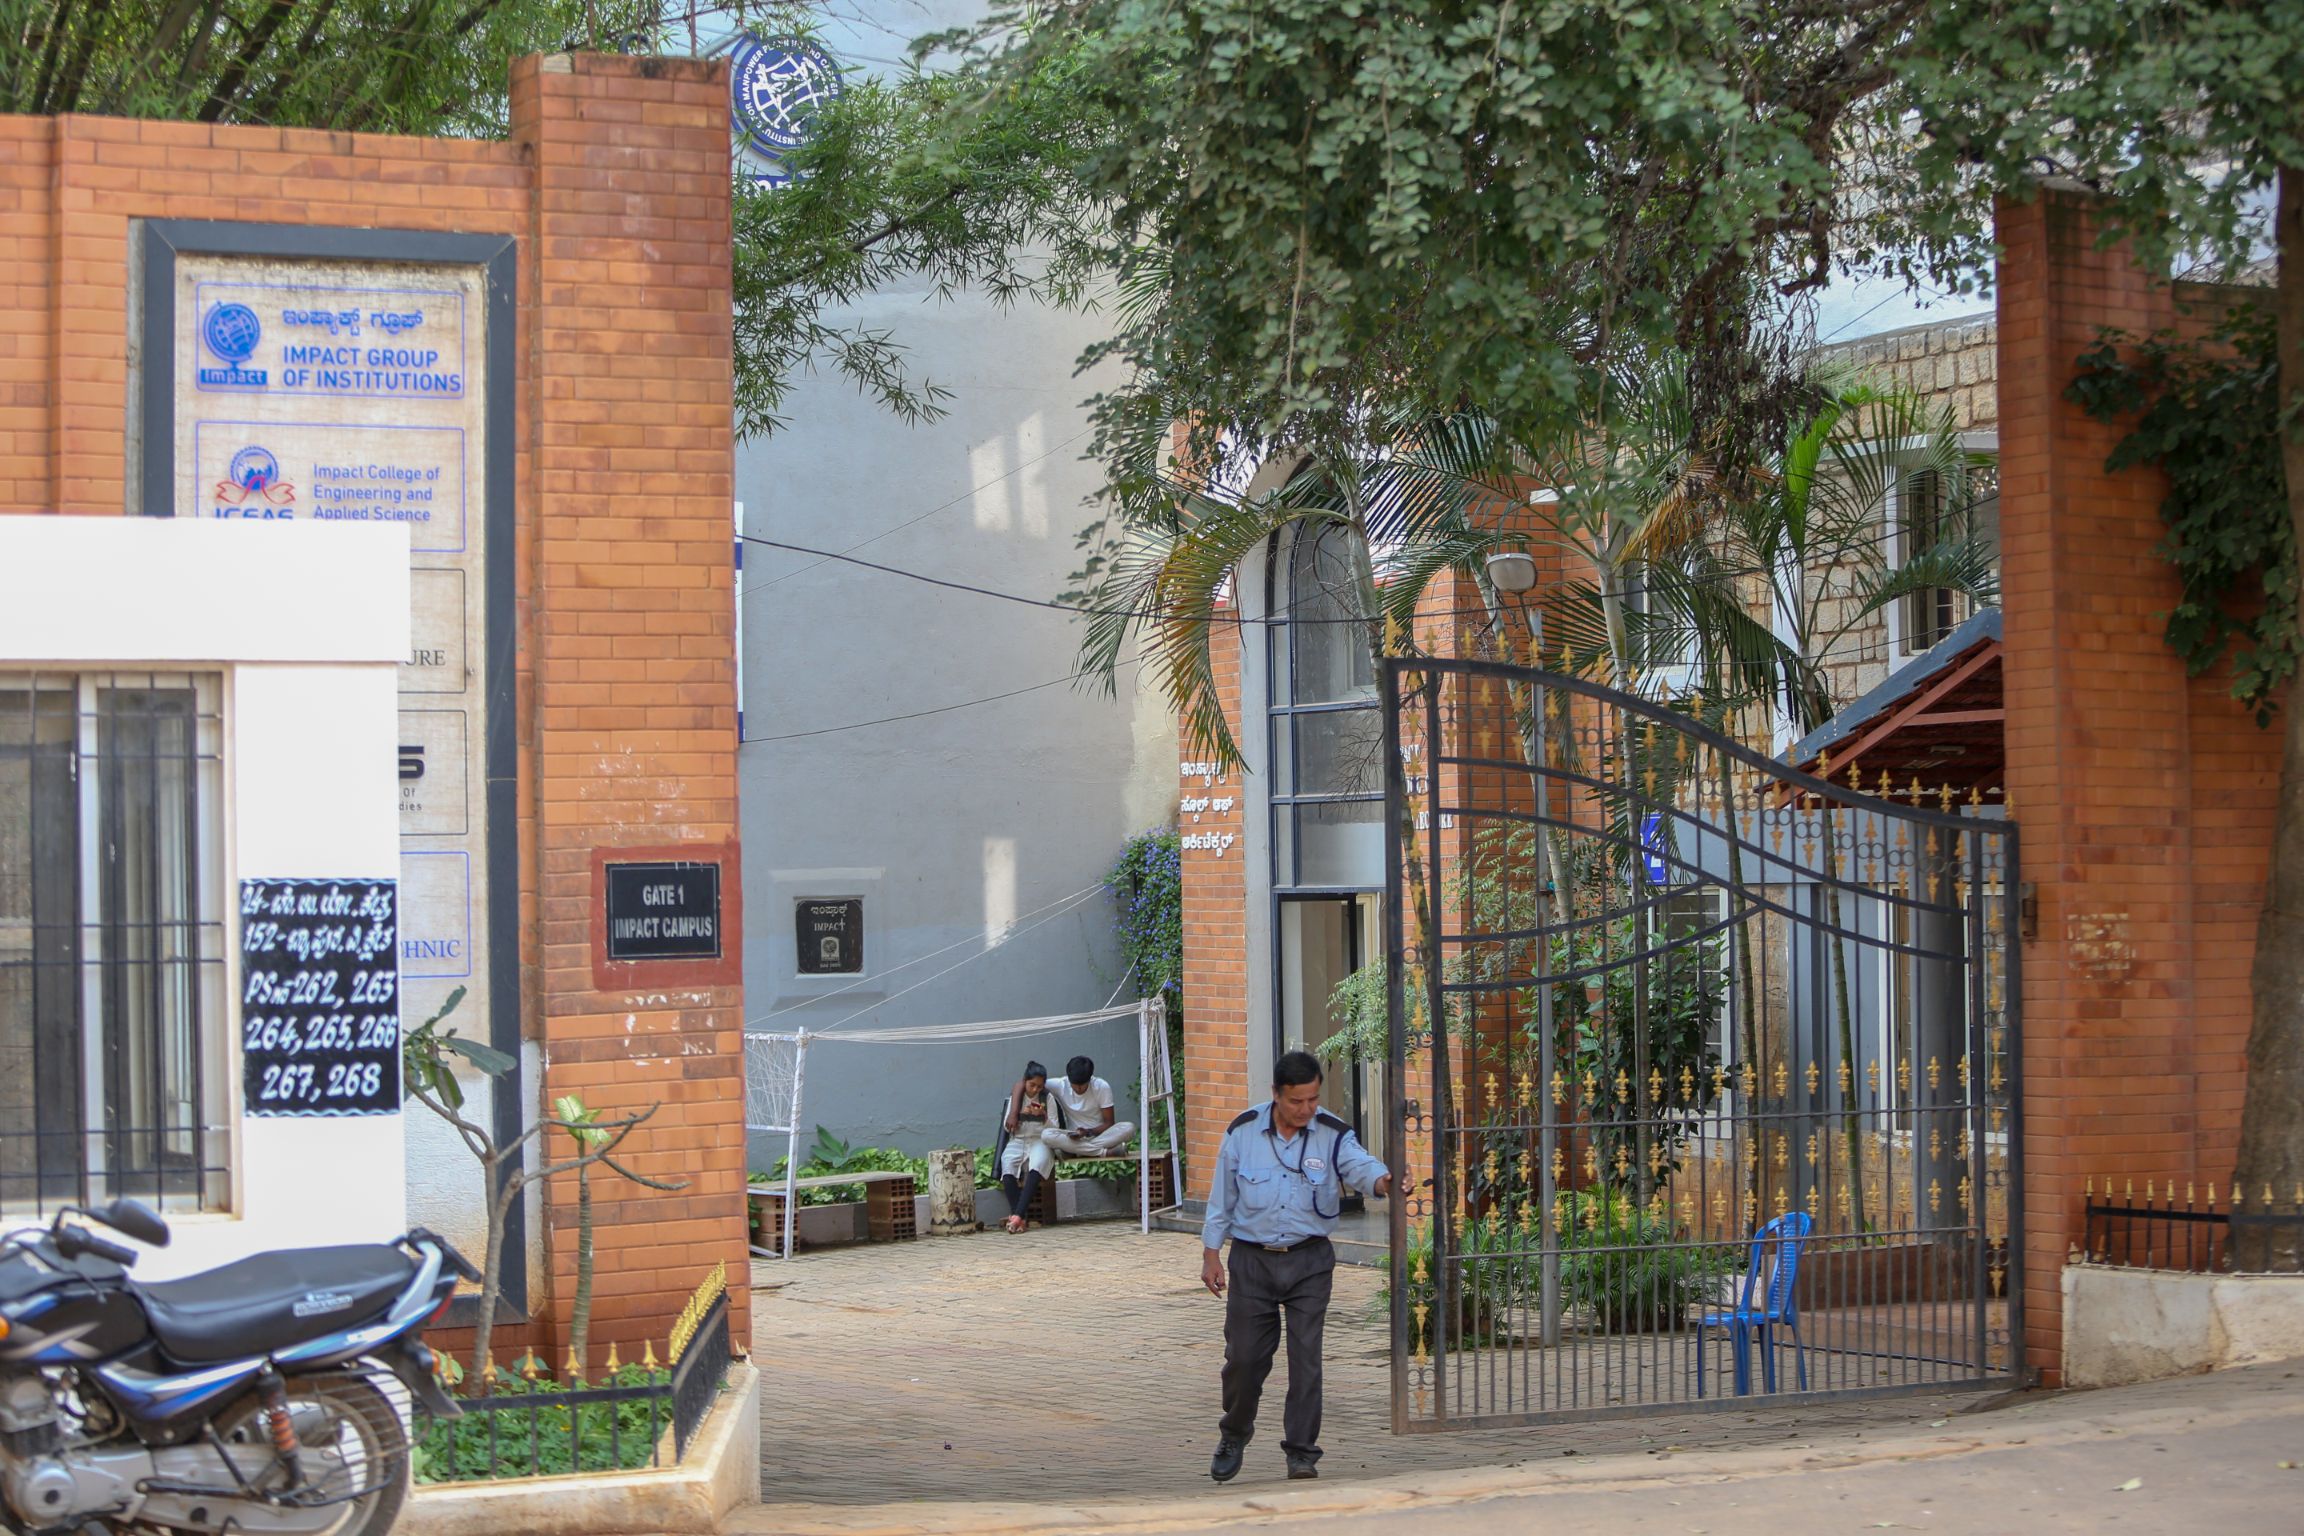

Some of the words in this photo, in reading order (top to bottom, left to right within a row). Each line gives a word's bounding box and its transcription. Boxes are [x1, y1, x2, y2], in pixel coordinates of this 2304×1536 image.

[742, 50, 764, 100] MANPOWER
[284, 345, 361, 366] IMPACT
[367, 349, 439, 368] GROUP
[283, 369, 310, 387] OF
[317, 370, 461, 392] INSTITUTIONS
[313, 463, 363, 480] Impact
[368, 465, 422, 483] College
[426, 466, 440, 480] of
[314, 484, 401, 504] Engineering
[406, 487, 432, 501] and
[313, 505, 368, 520] Applied
[374, 506, 430, 521] Science
[642, 884, 675, 906] GATE
[678, 884, 684, 905] 1
[615, 917, 660, 939] IMPACT
[662, 916, 713, 938] CAMPUS
[350, 970, 397, 1004] 263
[356, 1013, 399, 1049] 266
[260, 1064, 322, 1103] 267,
[326, 1062, 382, 1097] 268
